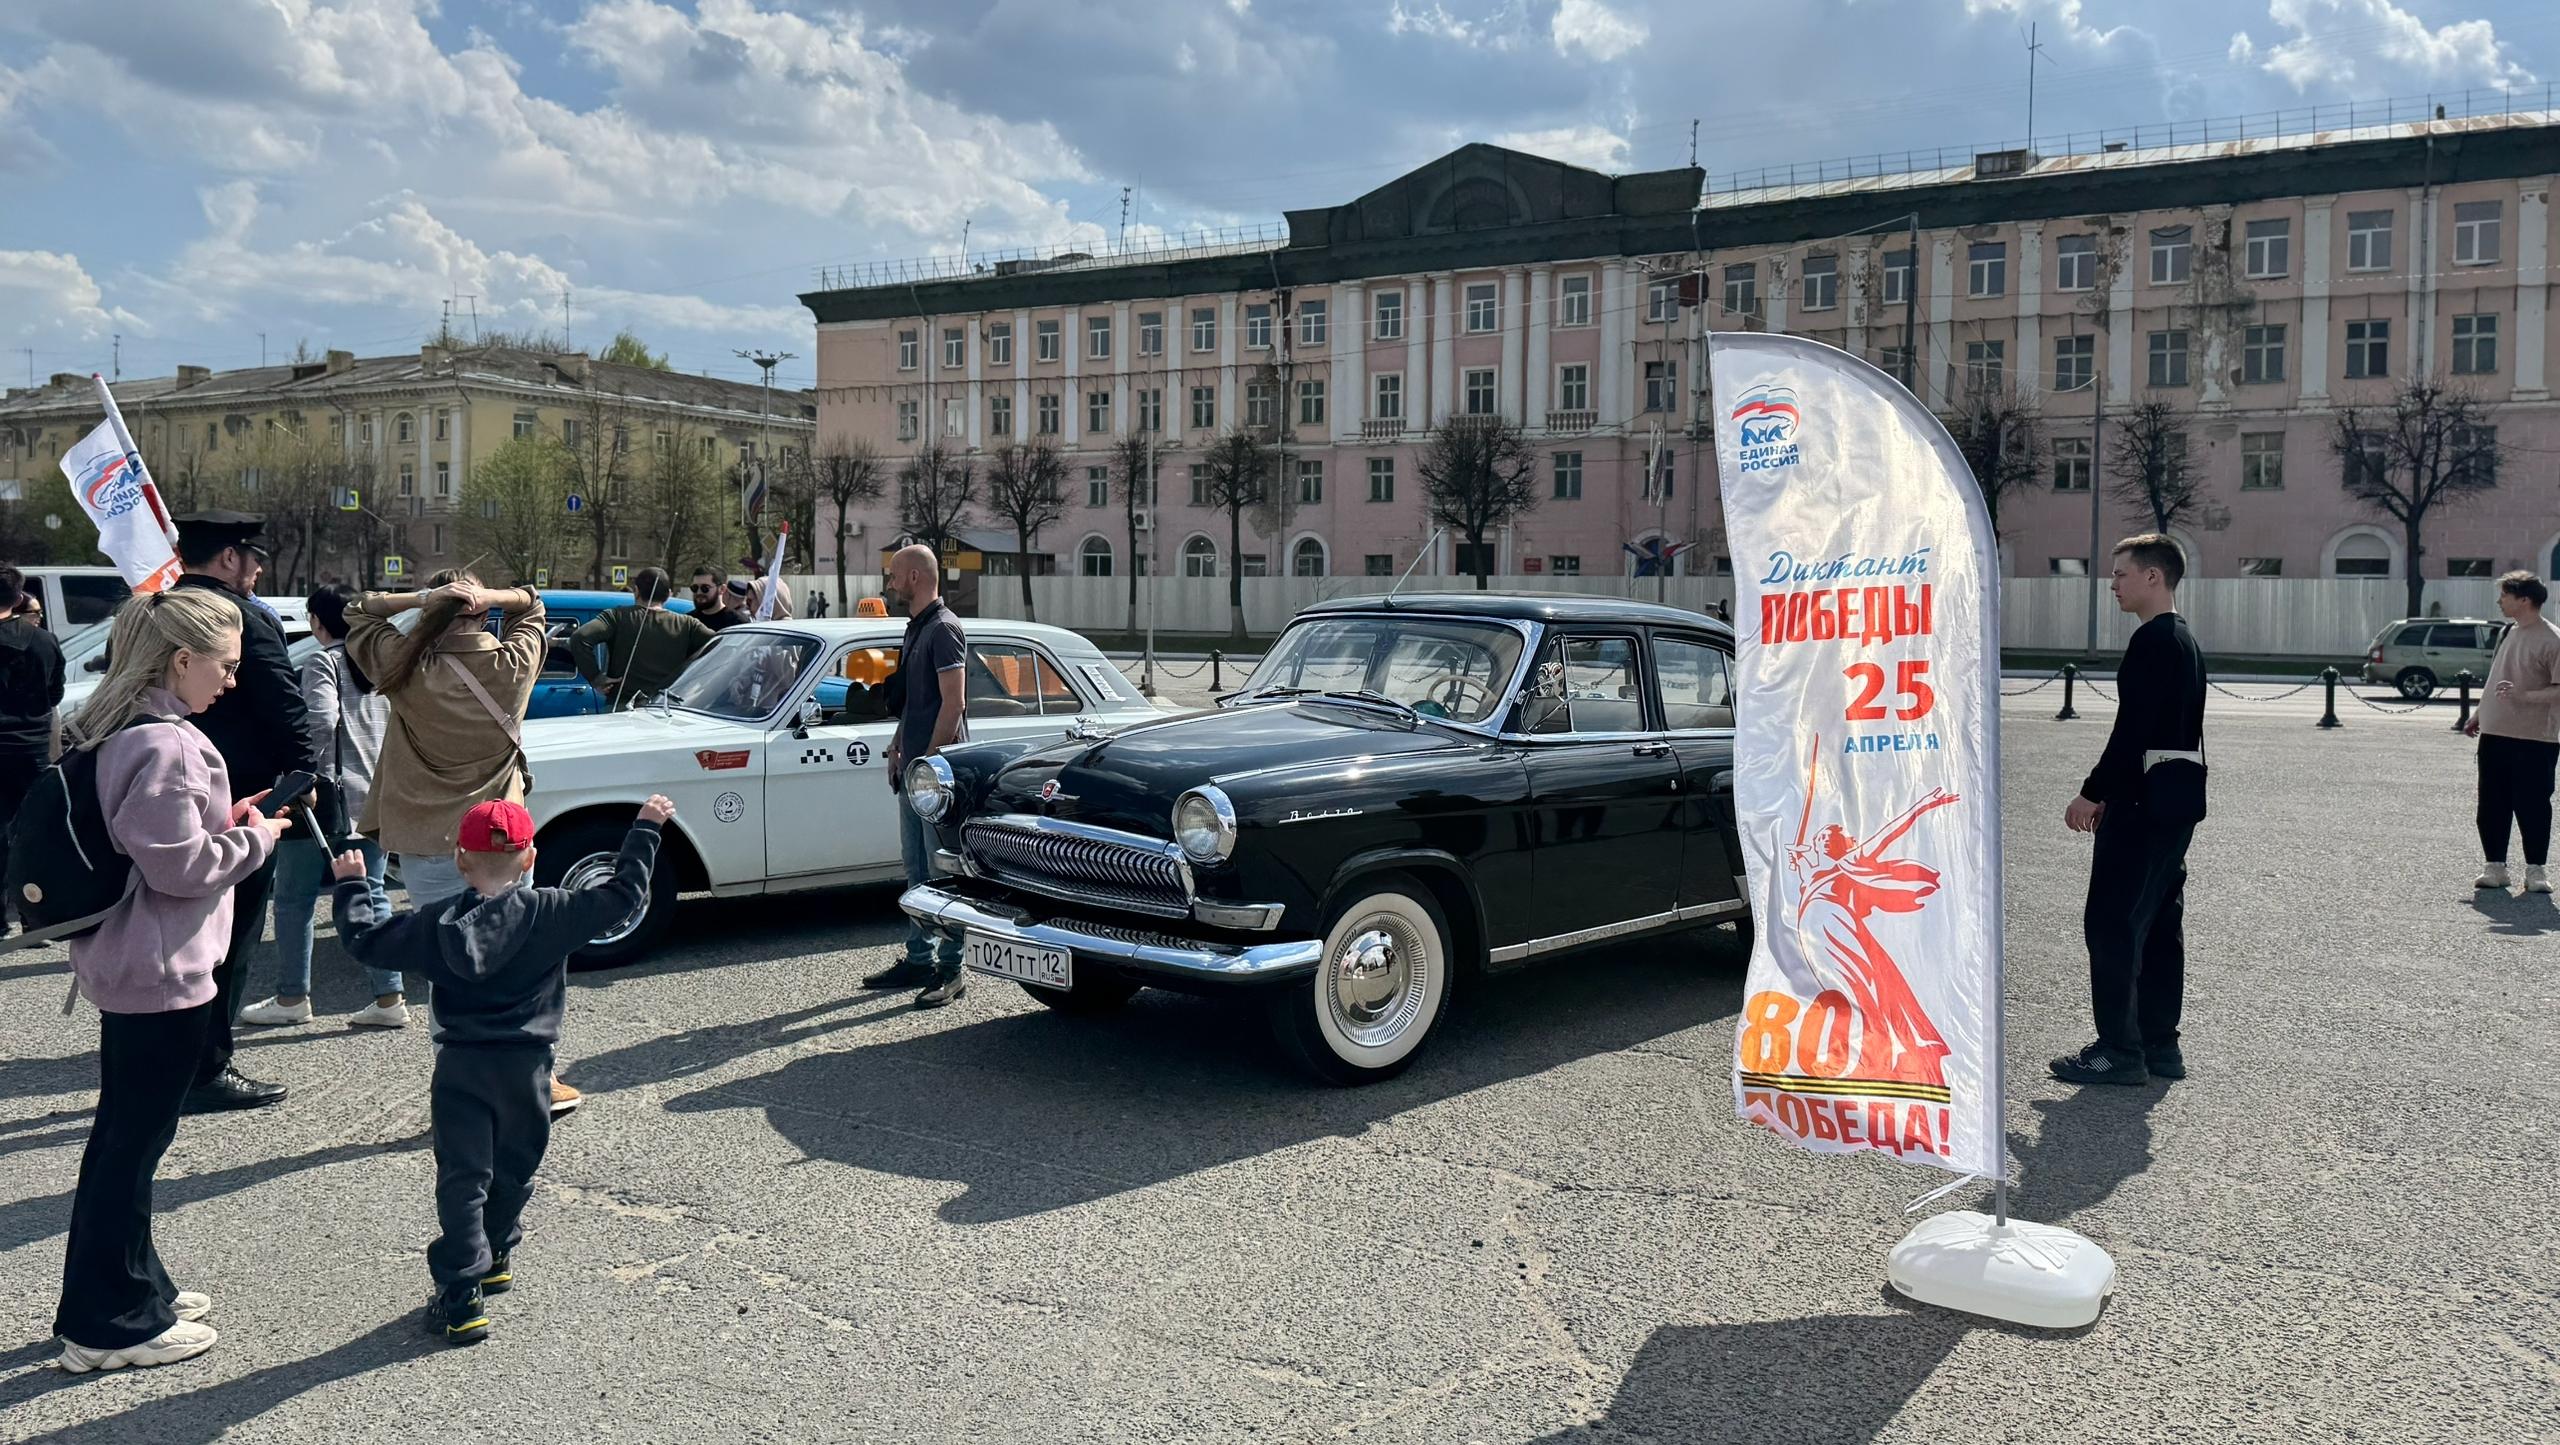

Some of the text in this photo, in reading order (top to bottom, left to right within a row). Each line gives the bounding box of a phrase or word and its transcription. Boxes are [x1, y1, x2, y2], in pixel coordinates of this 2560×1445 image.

[1739, 444, 1799, 461] ЕДИНАЯ
[1740, 454, 1800, 473] РОССИЯ
[1760, 547, 1931, 585] Диктант
[1760, 583, 1933, 647] ПОБЕДЫ
[1843, 660, 1934, 721] 25
[1844, 732, 1940, 754] АПРЕЛЯ
[1042, 952, 1060, 974] 12
[1041, 971, 1055, 981] RUS
[1740, 989, 1853, 1078] 80
